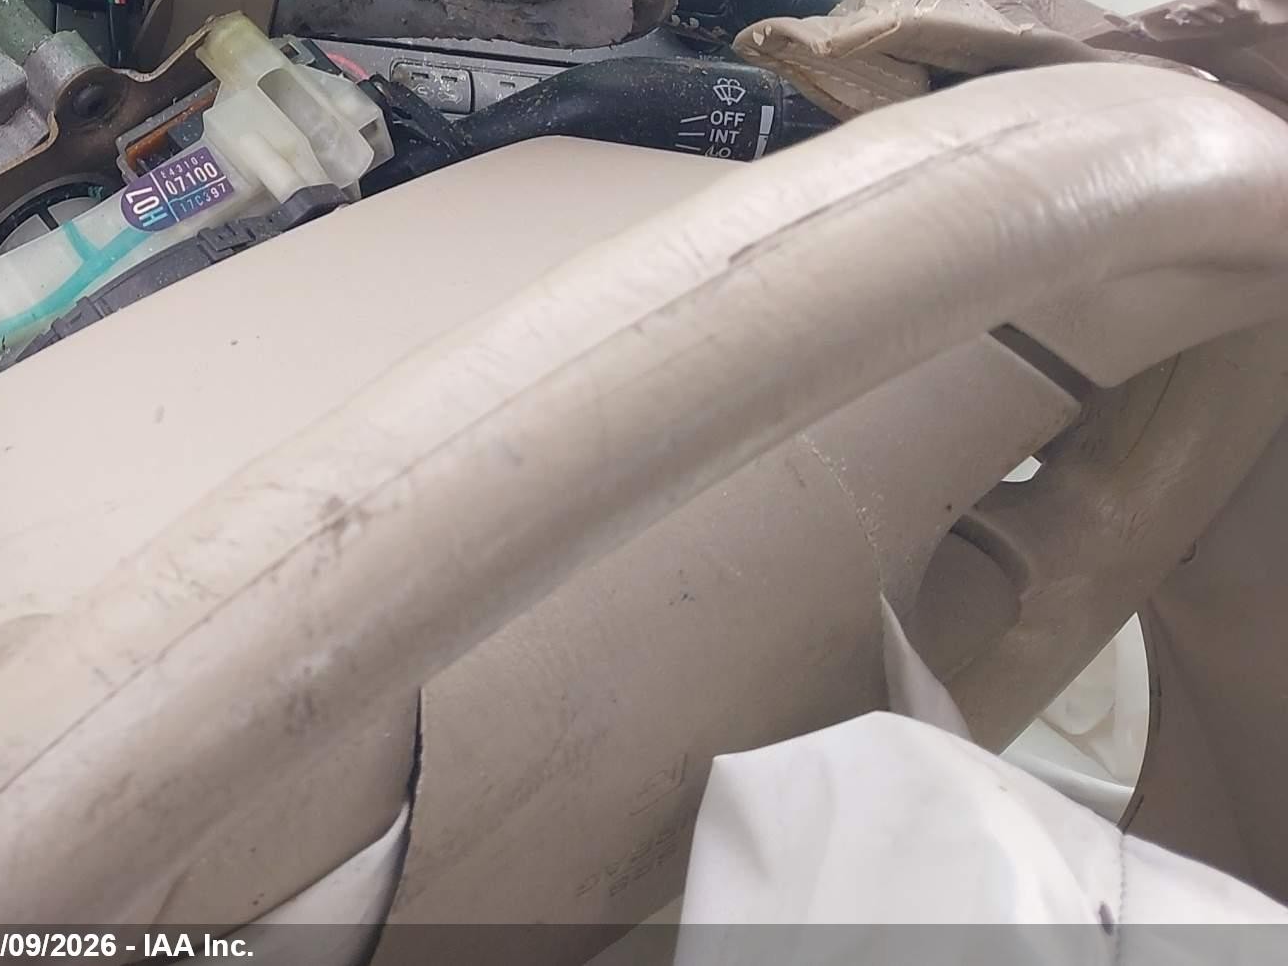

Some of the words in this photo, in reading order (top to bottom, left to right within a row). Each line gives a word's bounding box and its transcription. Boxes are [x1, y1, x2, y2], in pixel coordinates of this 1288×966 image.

[710, 110, 746, 127] OFF
[709, 129, 740, 144] INT
[165, 162, 218, 195] 07100
[125, 187, 169, 227] H07
